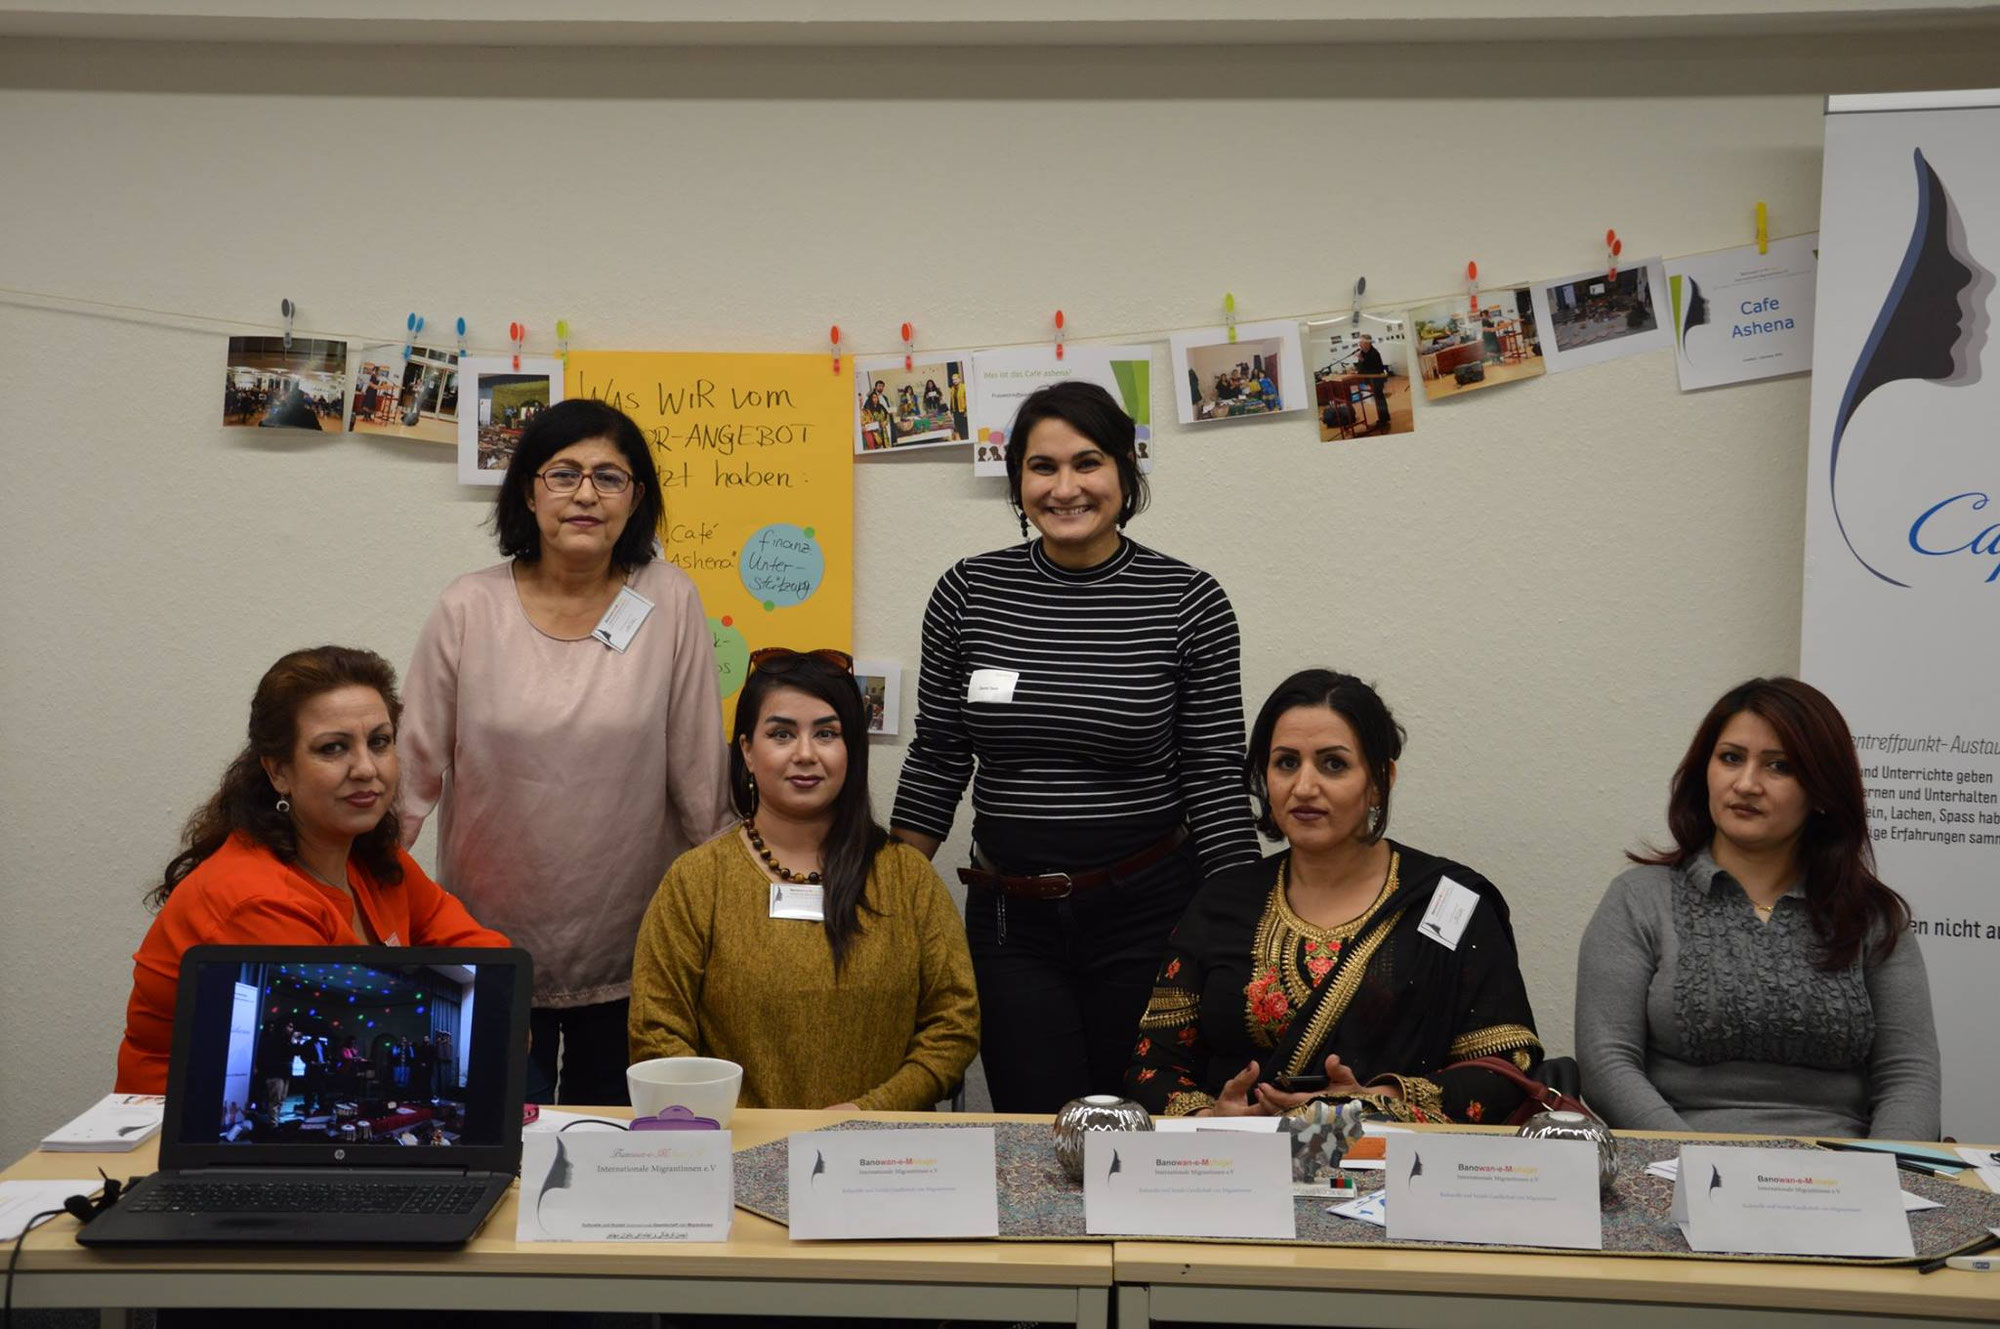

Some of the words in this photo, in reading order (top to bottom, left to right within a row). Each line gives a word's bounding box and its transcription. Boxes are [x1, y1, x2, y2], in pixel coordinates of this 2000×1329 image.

[1741, 297, 1780, 315] Cafe
[1732, 318, 1795, 338] Ashena
[1882, 766, 1953, 781] Unterrichte
[1957, 769, 1993, 785] geben
[1899, 788, 1921, 800] und
[1925, 788, 1998, 804] Unterhalten
[1891, 806, 1936, 823] Lachen,
[1940, 808, 1975, 824] Spass
[1891, 826, 1966, 845] Erfahrungen
[1935, 918, 1981, 938] nicht
